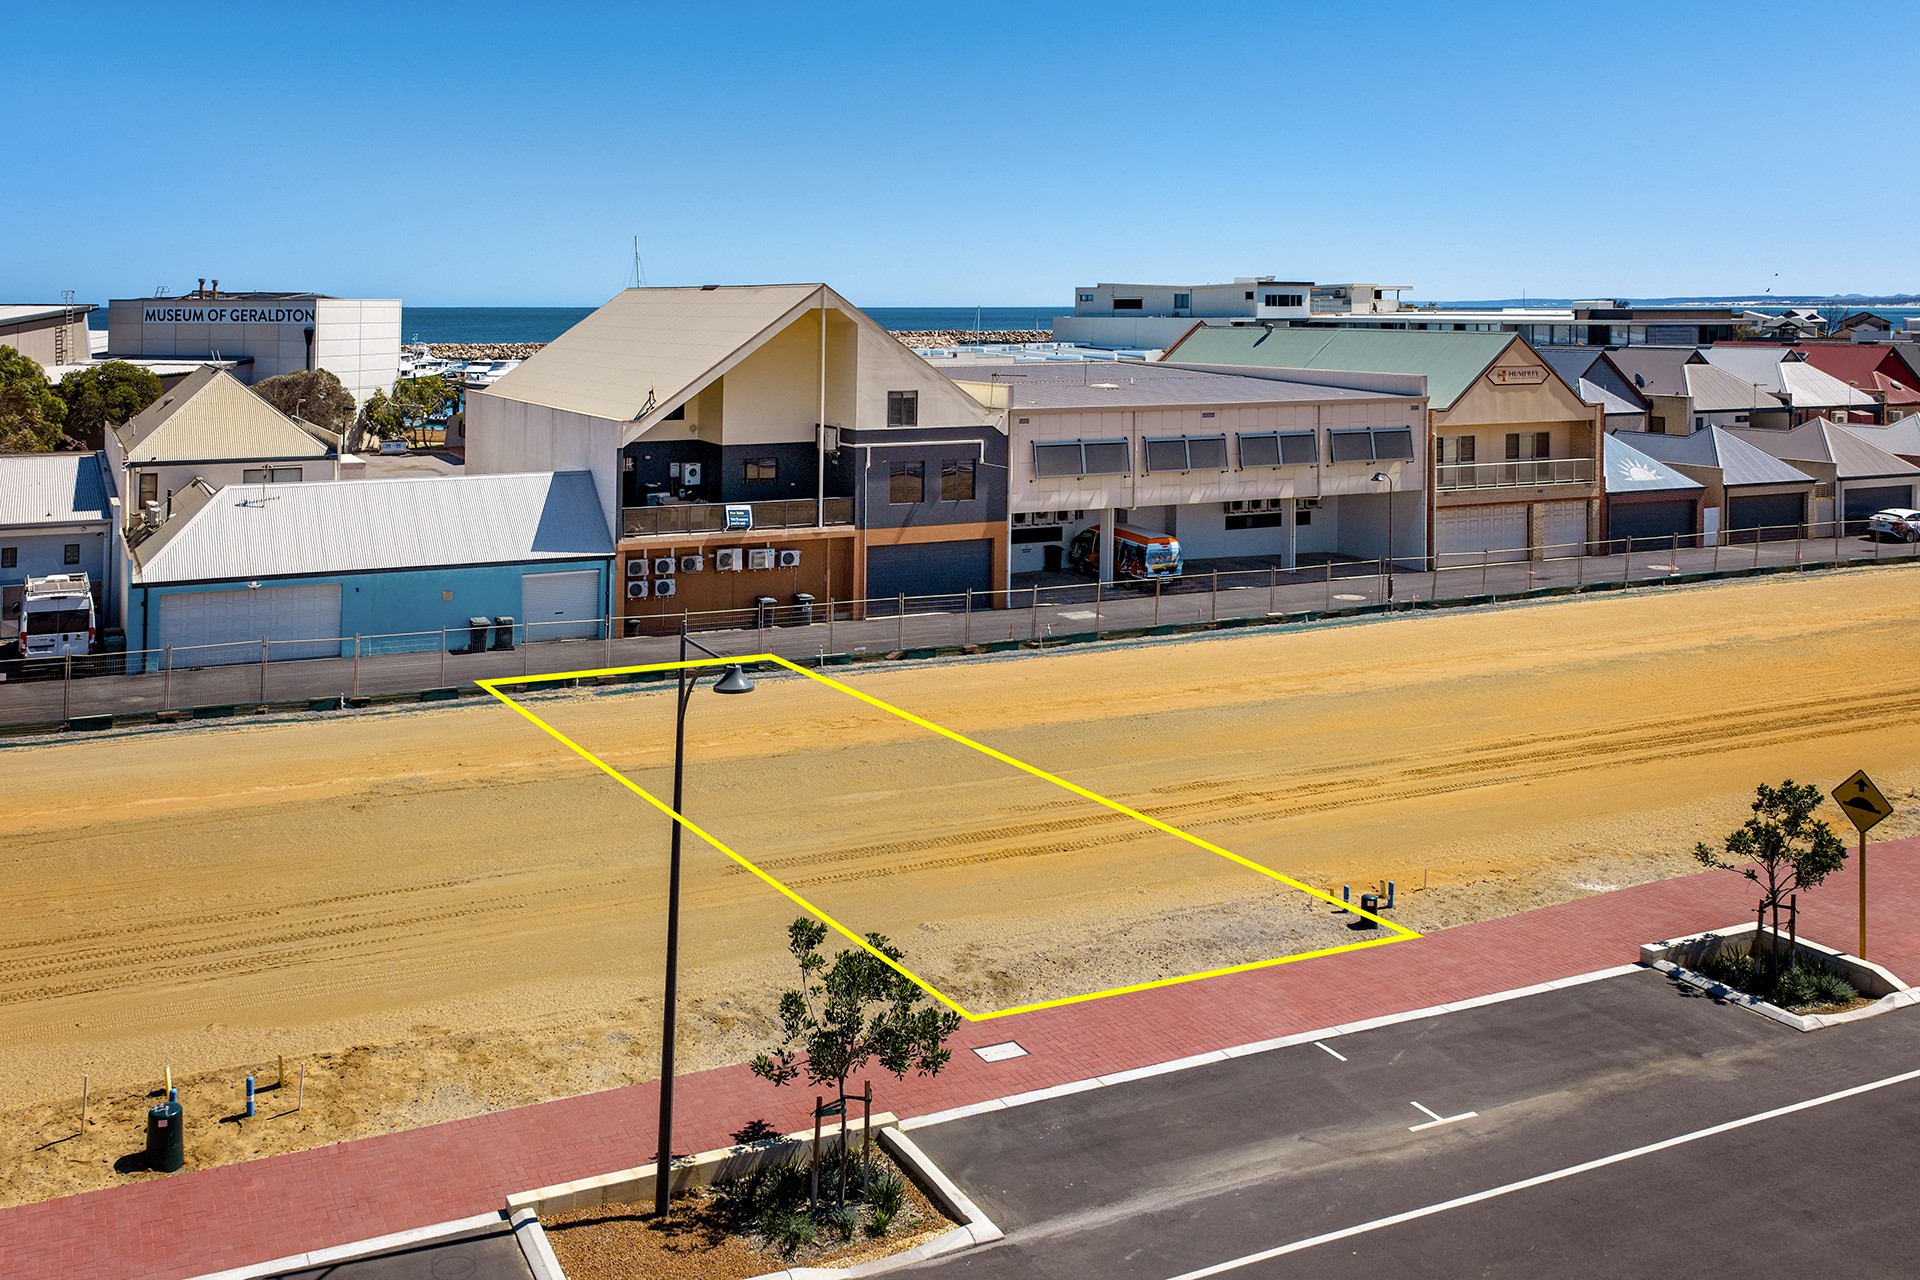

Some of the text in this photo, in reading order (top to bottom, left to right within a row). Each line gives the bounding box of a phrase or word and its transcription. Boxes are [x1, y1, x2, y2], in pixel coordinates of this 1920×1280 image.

[144, 309, 315, 322] MUSEUM OF GERALDTON
